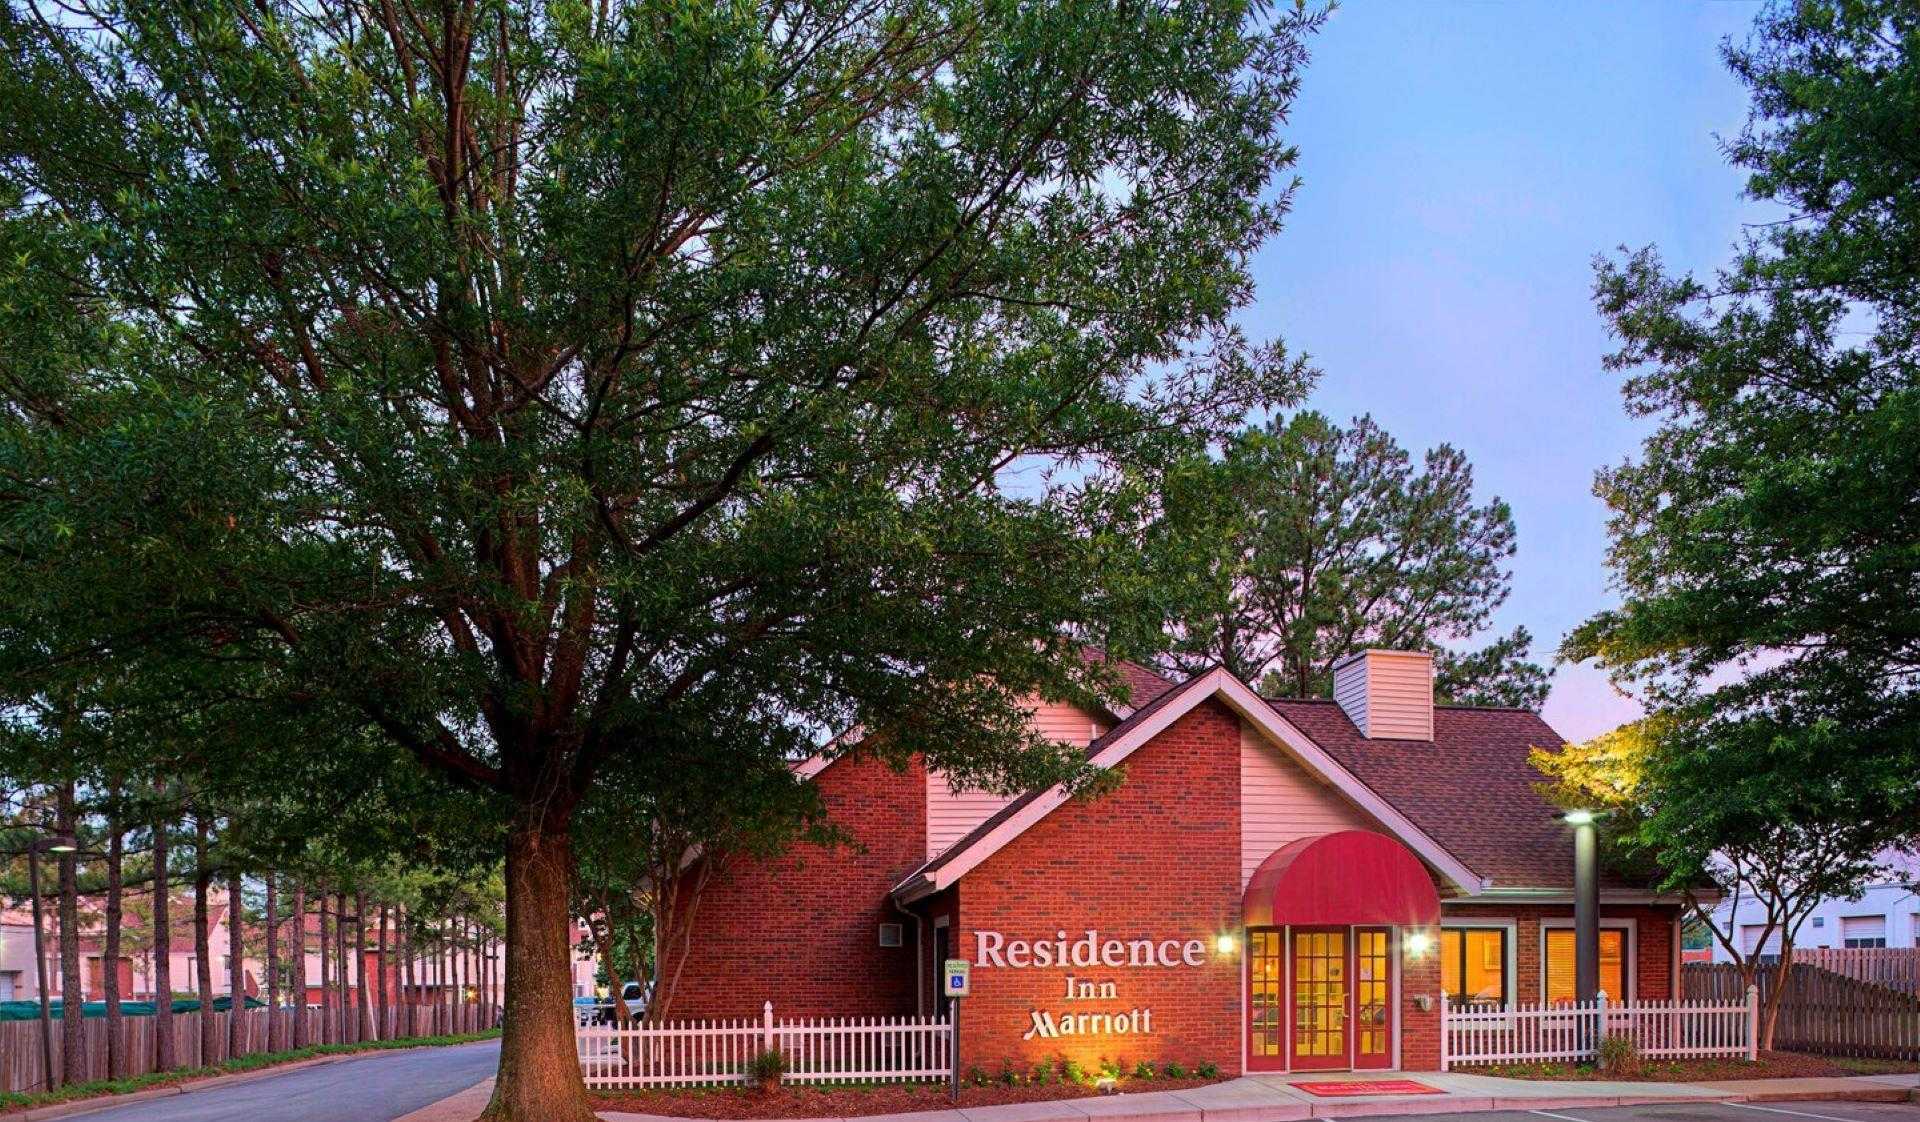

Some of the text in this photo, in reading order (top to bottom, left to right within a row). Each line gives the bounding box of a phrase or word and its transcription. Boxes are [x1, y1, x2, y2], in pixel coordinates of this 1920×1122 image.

[974, 930, 1206, 968] Residence
[1065, 976, 1118, 1000] Inn
[1023, 1008, 1152, 1040] Marriott
